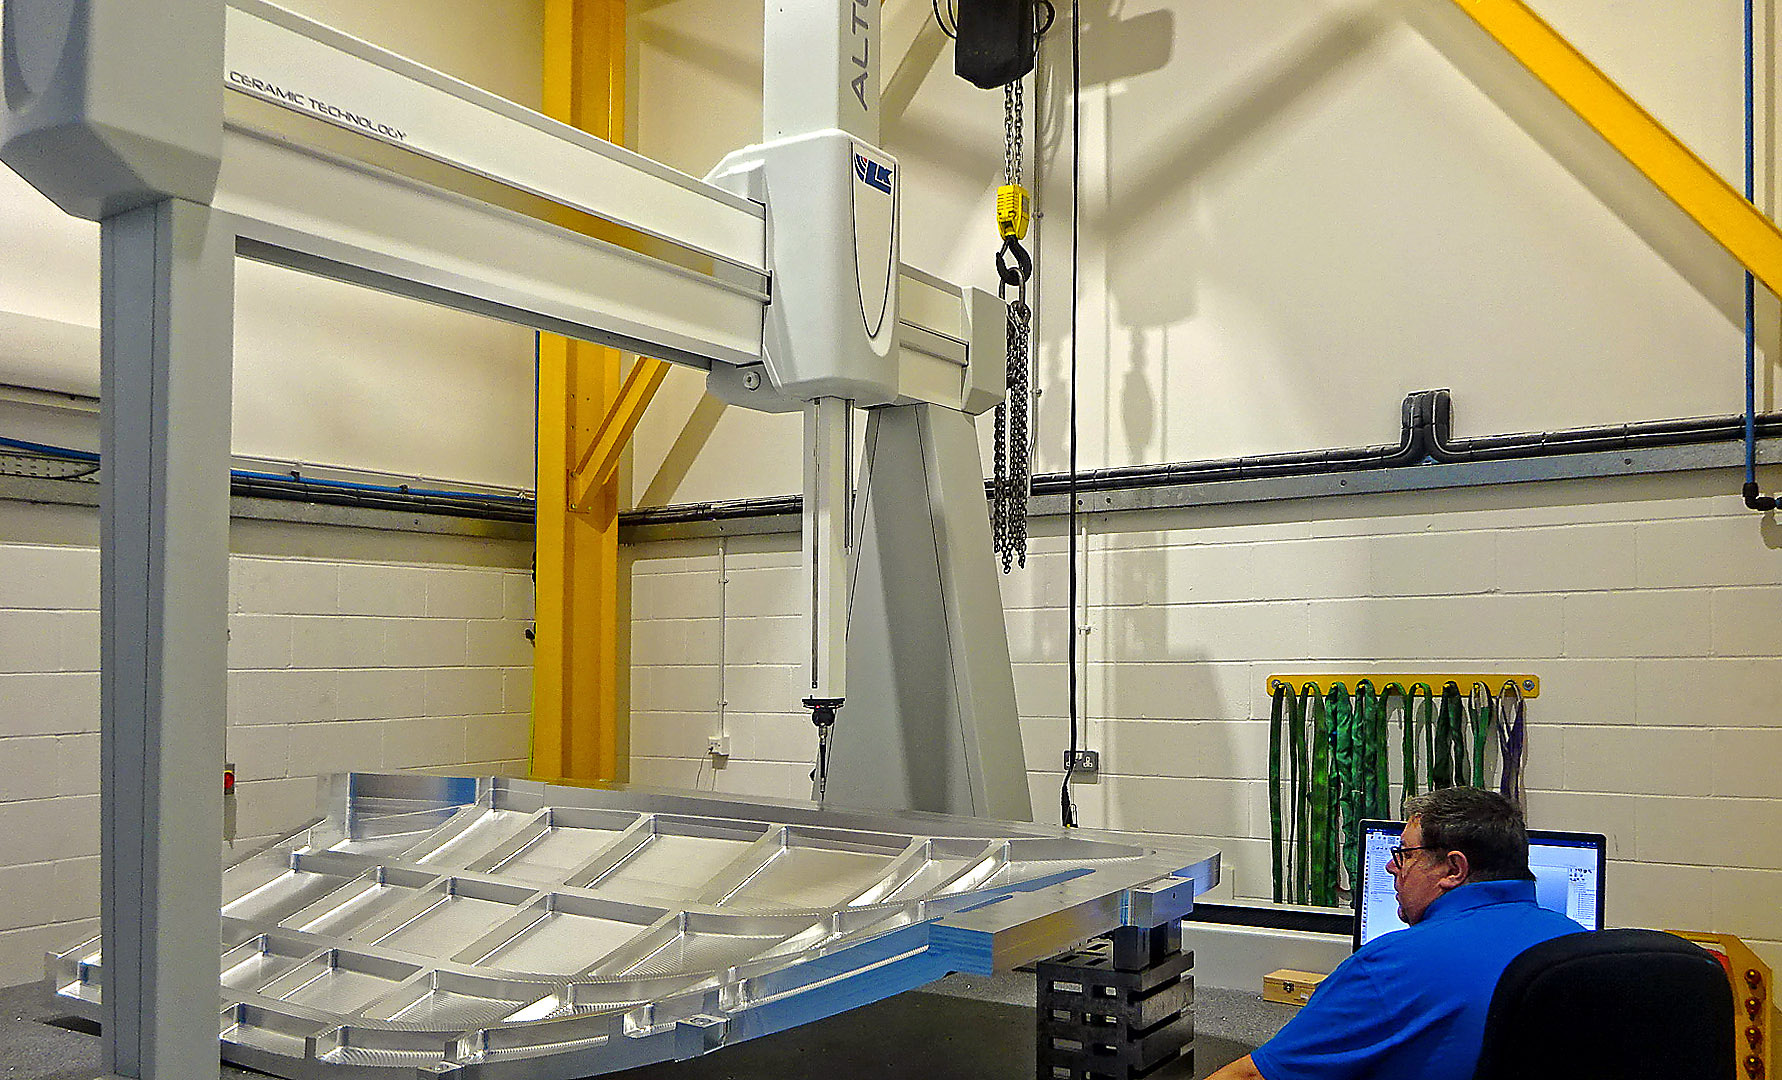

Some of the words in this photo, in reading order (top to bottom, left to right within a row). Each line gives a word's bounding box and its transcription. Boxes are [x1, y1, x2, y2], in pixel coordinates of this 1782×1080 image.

[851, 0, 869, 112] ALT
[229, 71, 305, 106] CERAMIC
[308, 97, 408, 141] TECHNOLOGY
[863, 158, 893, 196] LK
